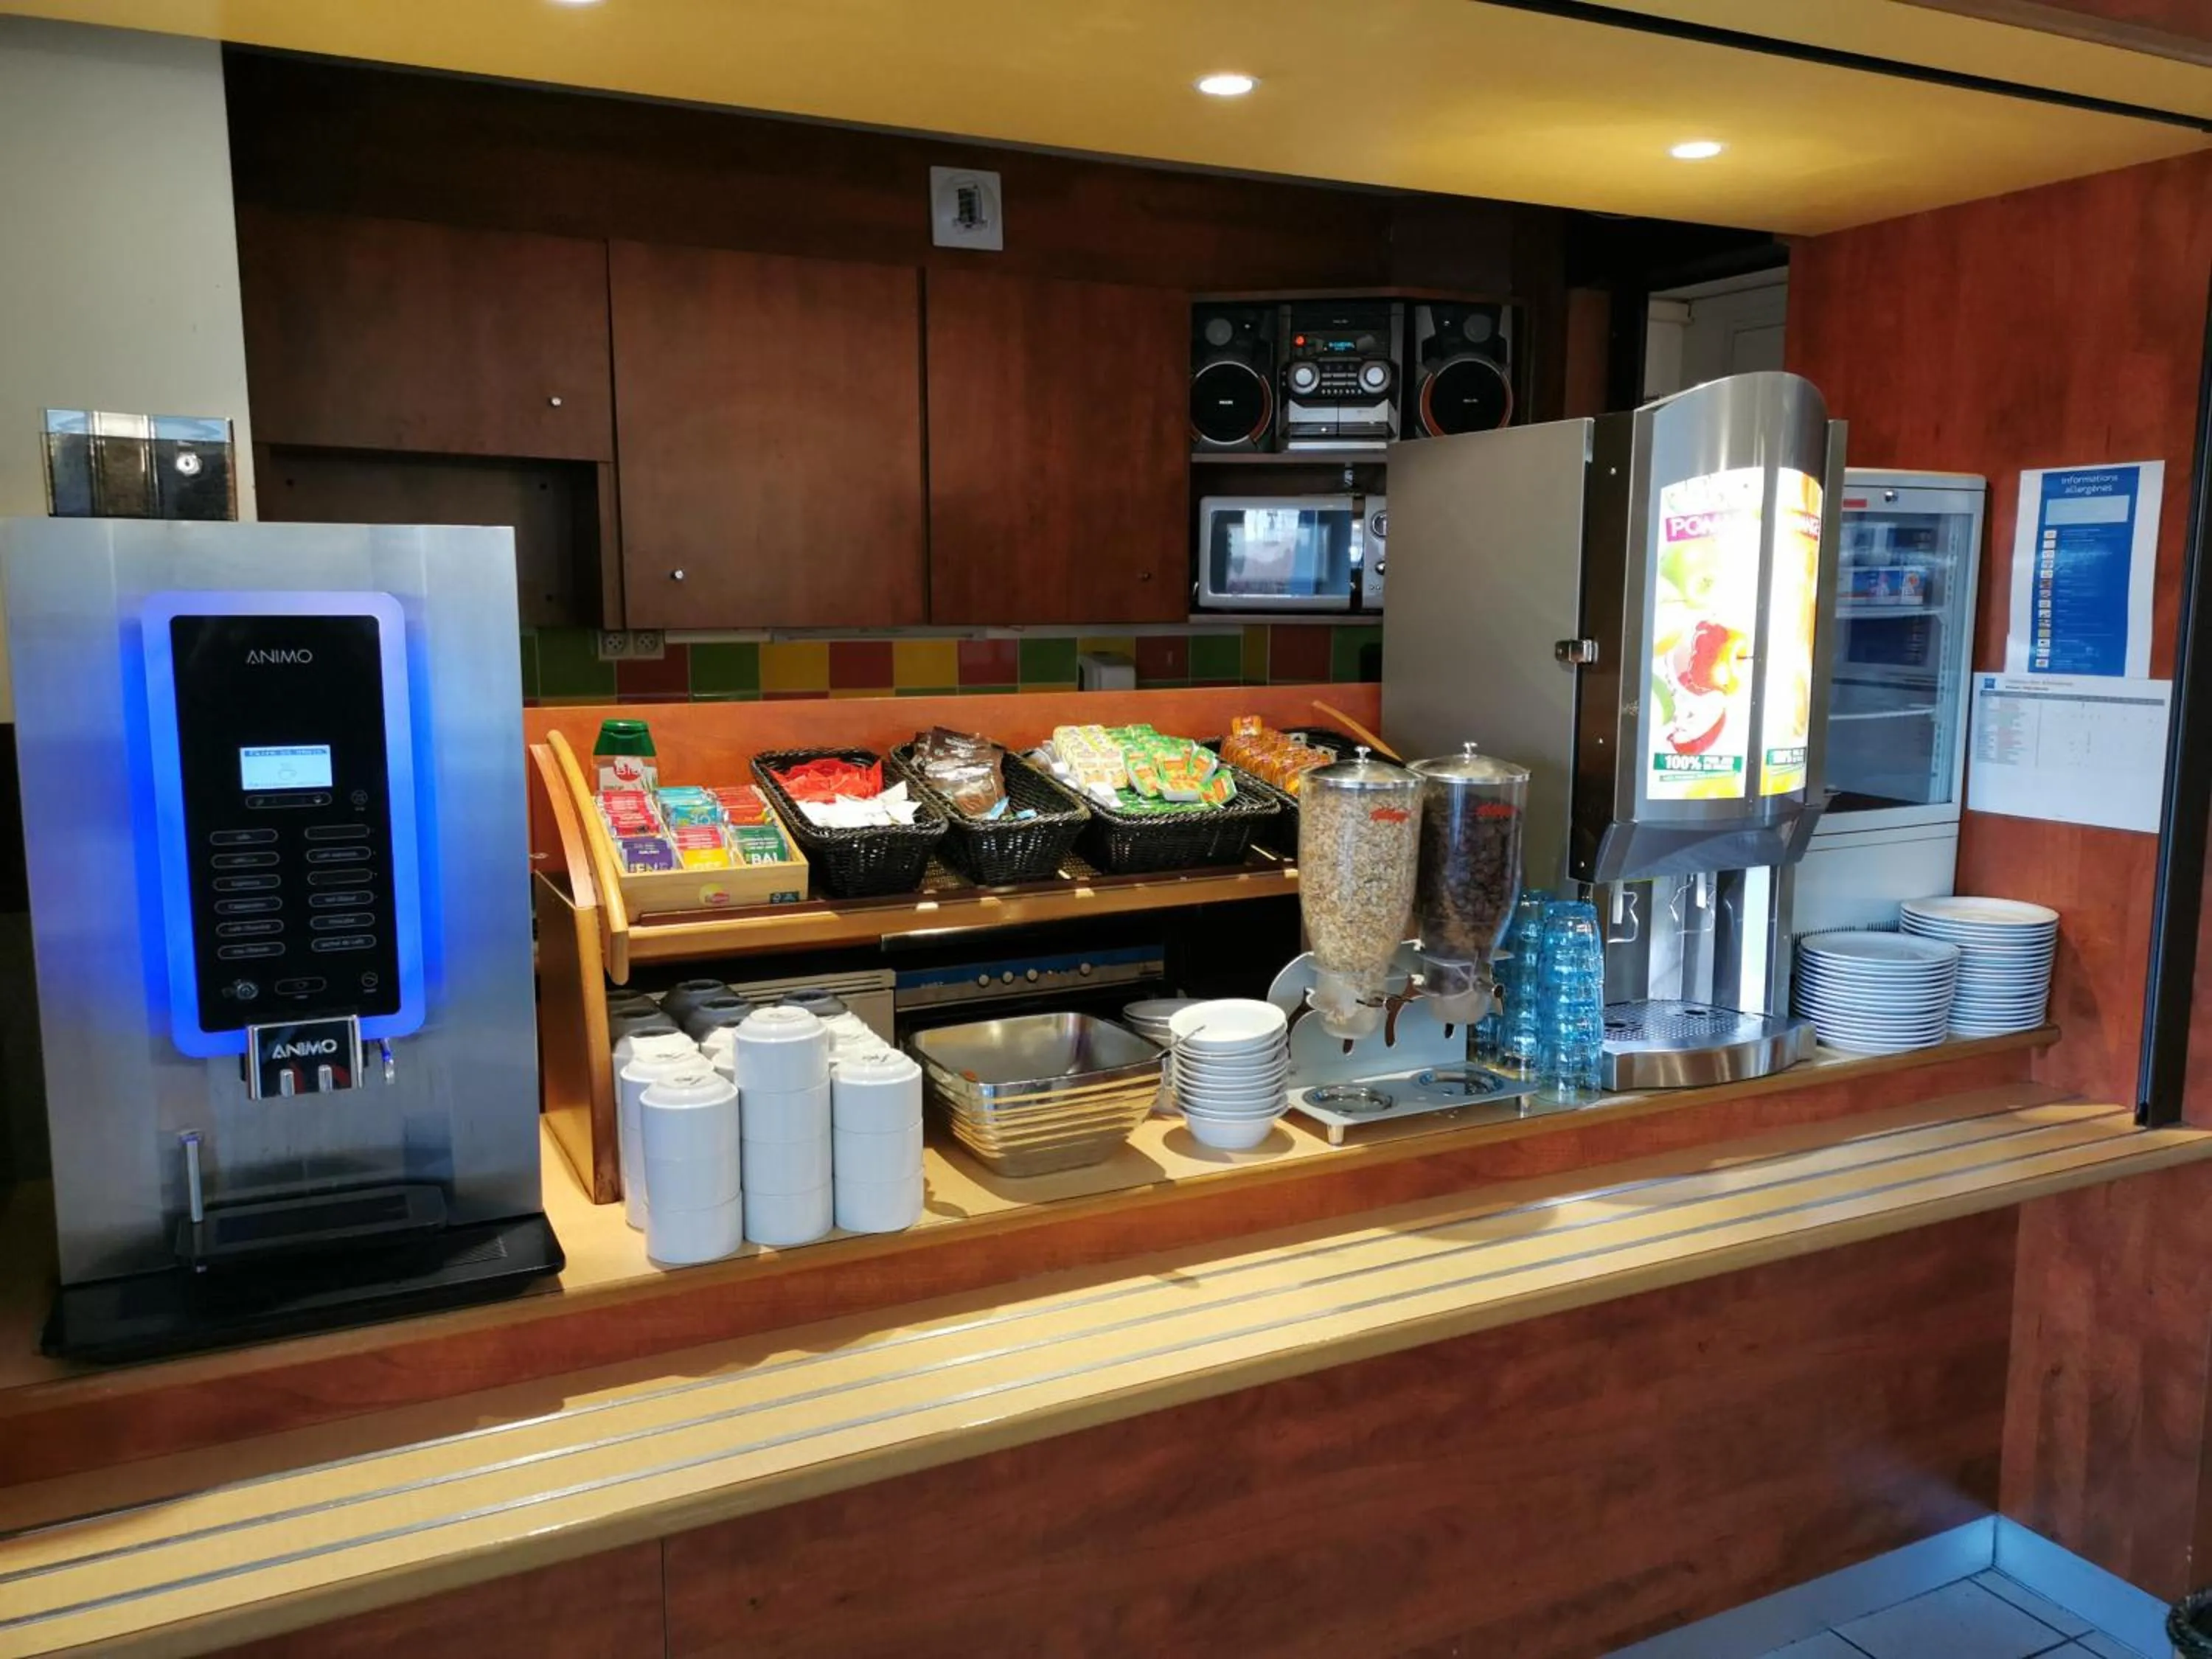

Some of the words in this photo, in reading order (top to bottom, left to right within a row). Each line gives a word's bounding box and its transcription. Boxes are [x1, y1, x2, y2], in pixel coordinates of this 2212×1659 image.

[246, 648, 313, 664] ANIMO
[1664, 754, 1703, 771] 100%
[271, 1039, 338, 1059] ANIMO
